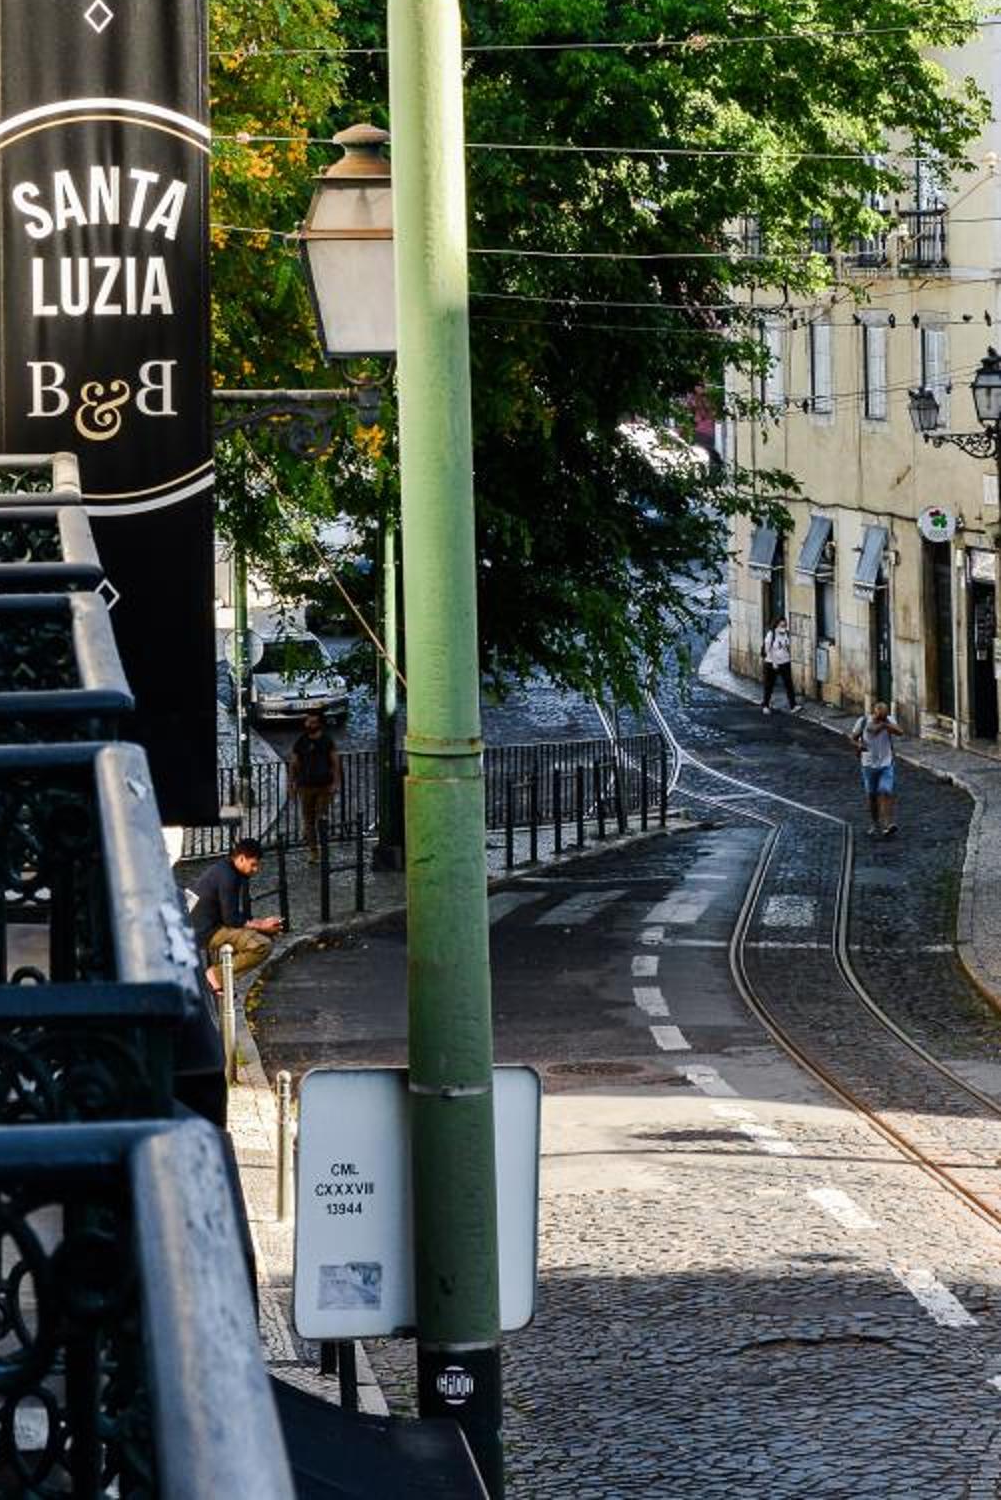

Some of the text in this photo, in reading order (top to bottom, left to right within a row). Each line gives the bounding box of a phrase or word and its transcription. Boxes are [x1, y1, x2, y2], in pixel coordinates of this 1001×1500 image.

[12, 165, 187, 241] SANTA
[32, 257, 174, 316] LUZIA
[330, 1163, 359, 1176] CML
[327, 1202, 362, 1215] 13944
